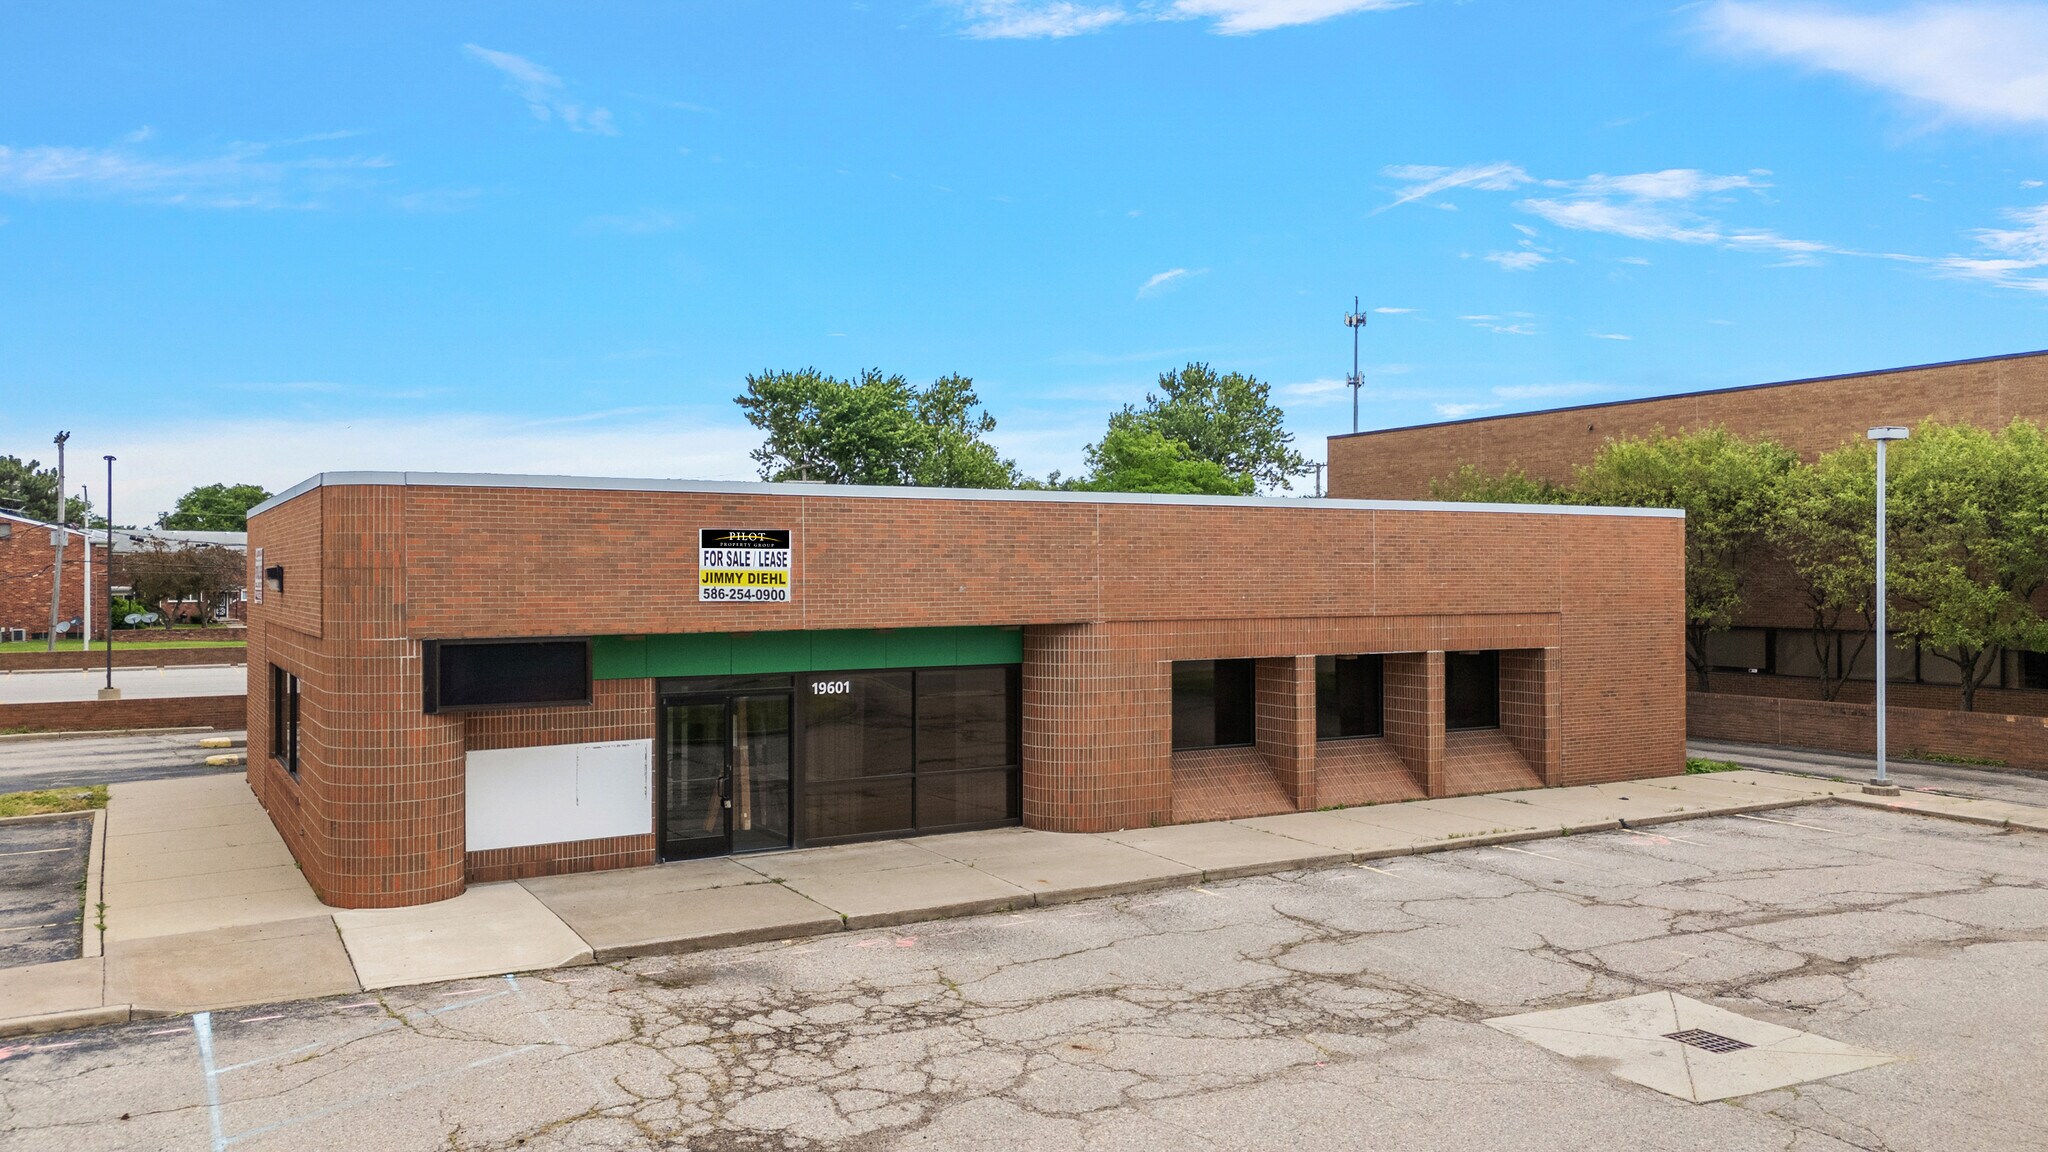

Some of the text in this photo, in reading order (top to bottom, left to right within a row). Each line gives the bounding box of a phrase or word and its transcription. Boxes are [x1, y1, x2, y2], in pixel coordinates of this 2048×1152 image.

[729, 532, 766, 541] PILOT
[704, 551, 723, 566] FOR
[726, 551, 750, 567] SALE
[759, 551, 787, 567] LEASE
[702, 572, 786, 584] JIMMY DIEHL
[703, 588, 786, 600] 586-254-0900
[811, 681, 850, 694] 19601
